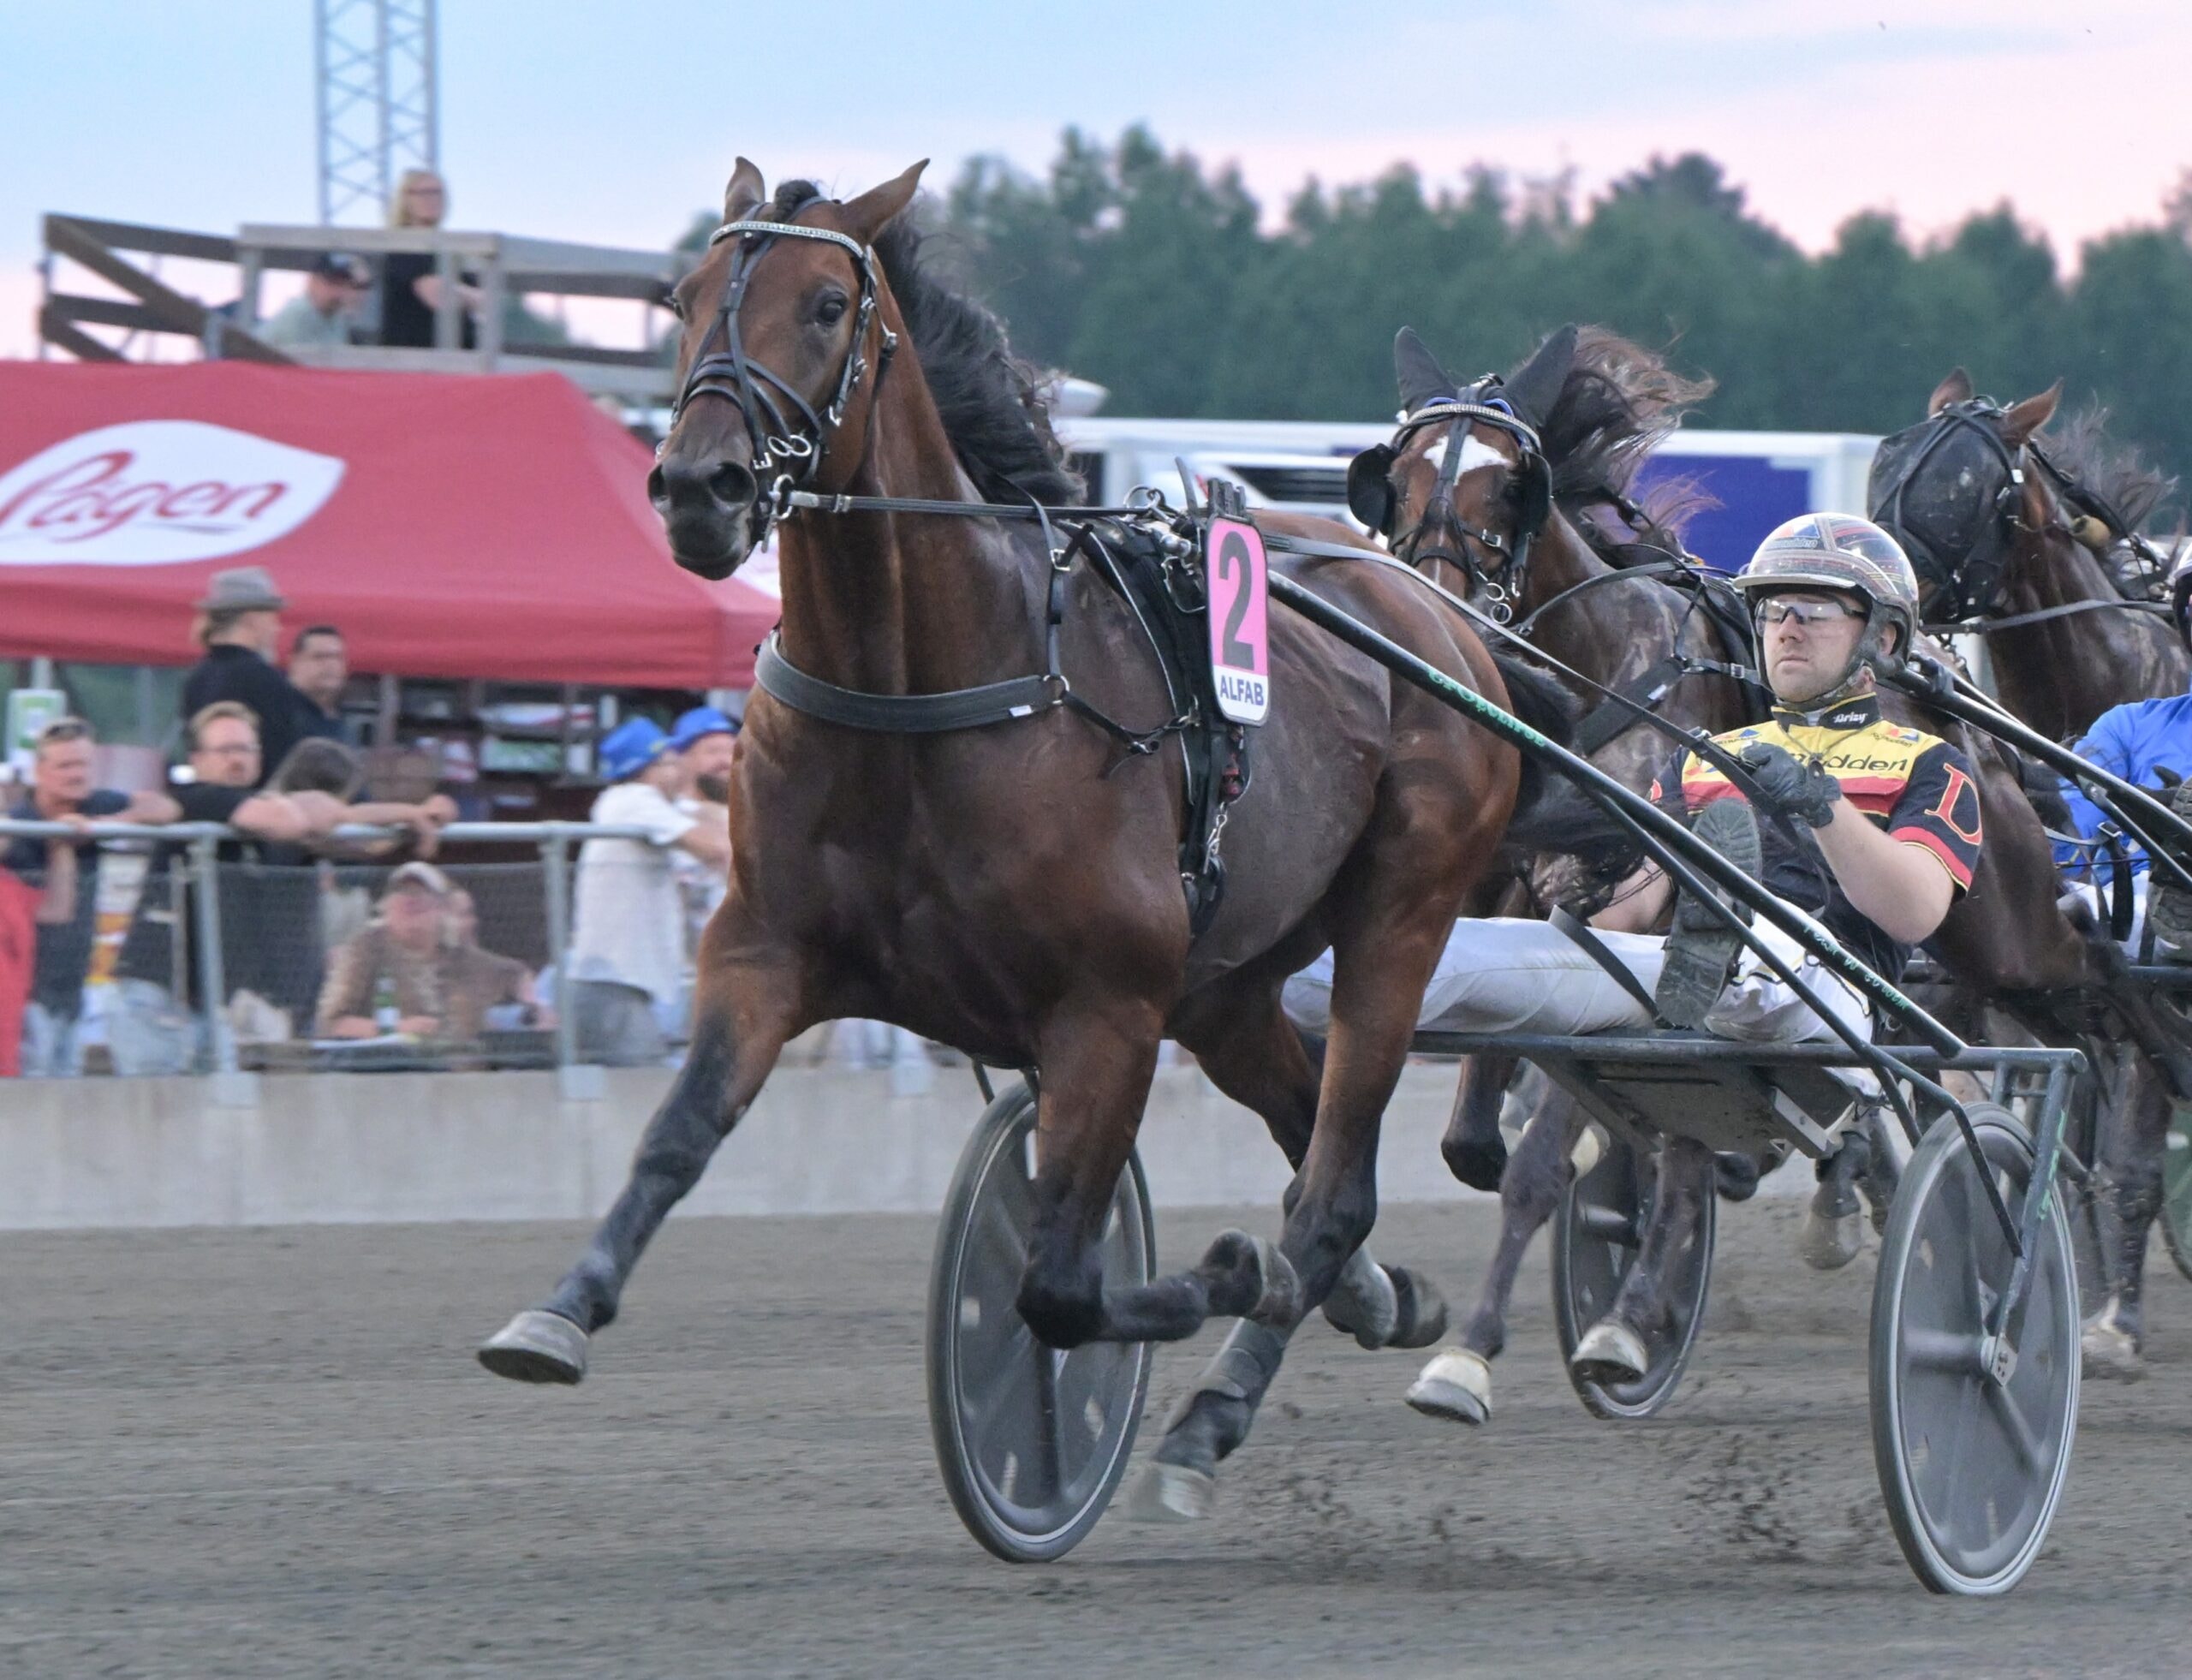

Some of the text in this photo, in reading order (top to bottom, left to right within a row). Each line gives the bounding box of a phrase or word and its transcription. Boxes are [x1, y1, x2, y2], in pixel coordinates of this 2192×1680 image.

[1218, 530, 1255, 671] 2
[1219, 675, 1265, 706] ALFAB
[1925, 762, 1983, 846] D
